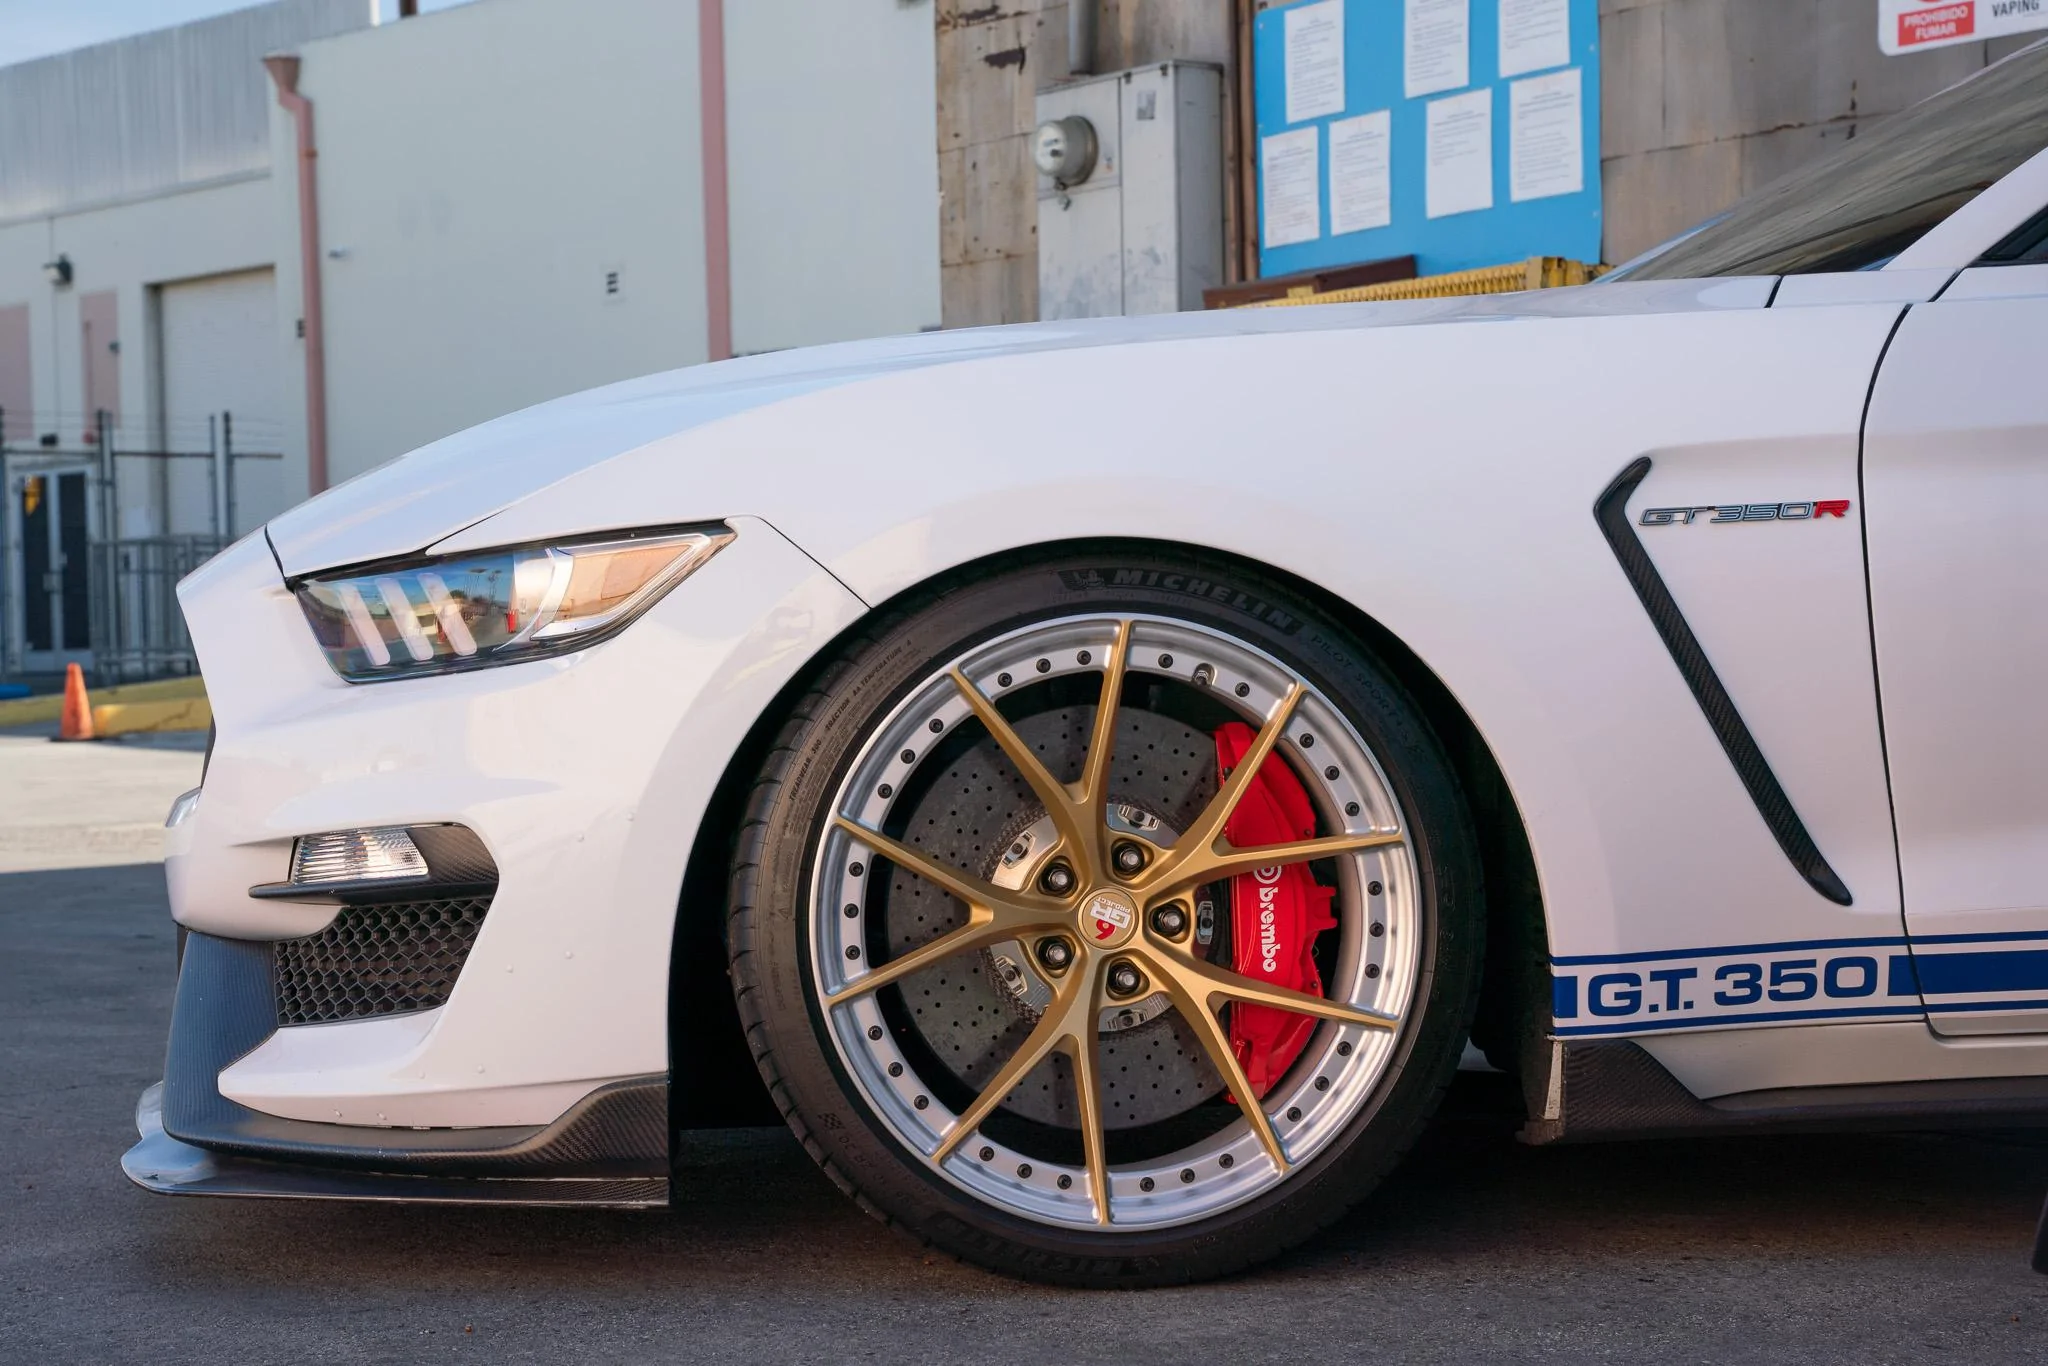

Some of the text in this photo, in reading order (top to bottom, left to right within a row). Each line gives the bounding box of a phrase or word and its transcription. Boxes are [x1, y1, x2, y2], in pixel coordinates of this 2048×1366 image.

[1904, 5, 1969, 28] PROHIBIDO
[1992, 0, 2040, 17] VAPING
[1915, 22, 1957, 40] FUMAR
[1638, 499, 1850, 526] GT350R
[1113, 567, 1296, 632] MICHELIN
[1310, 633, 1353, 670] PILOT
[789, 757, 813, 801] TREADWEAR
[824, 698, 851, 731] TRACTION
[860, 646, 902, 686] TEMPERATURE
[1095, 896, 1131, 914] PROJECT
[1259, 887, 1281, 973] brembo
[1587, 956, 1878, 1017] G.T. 350
